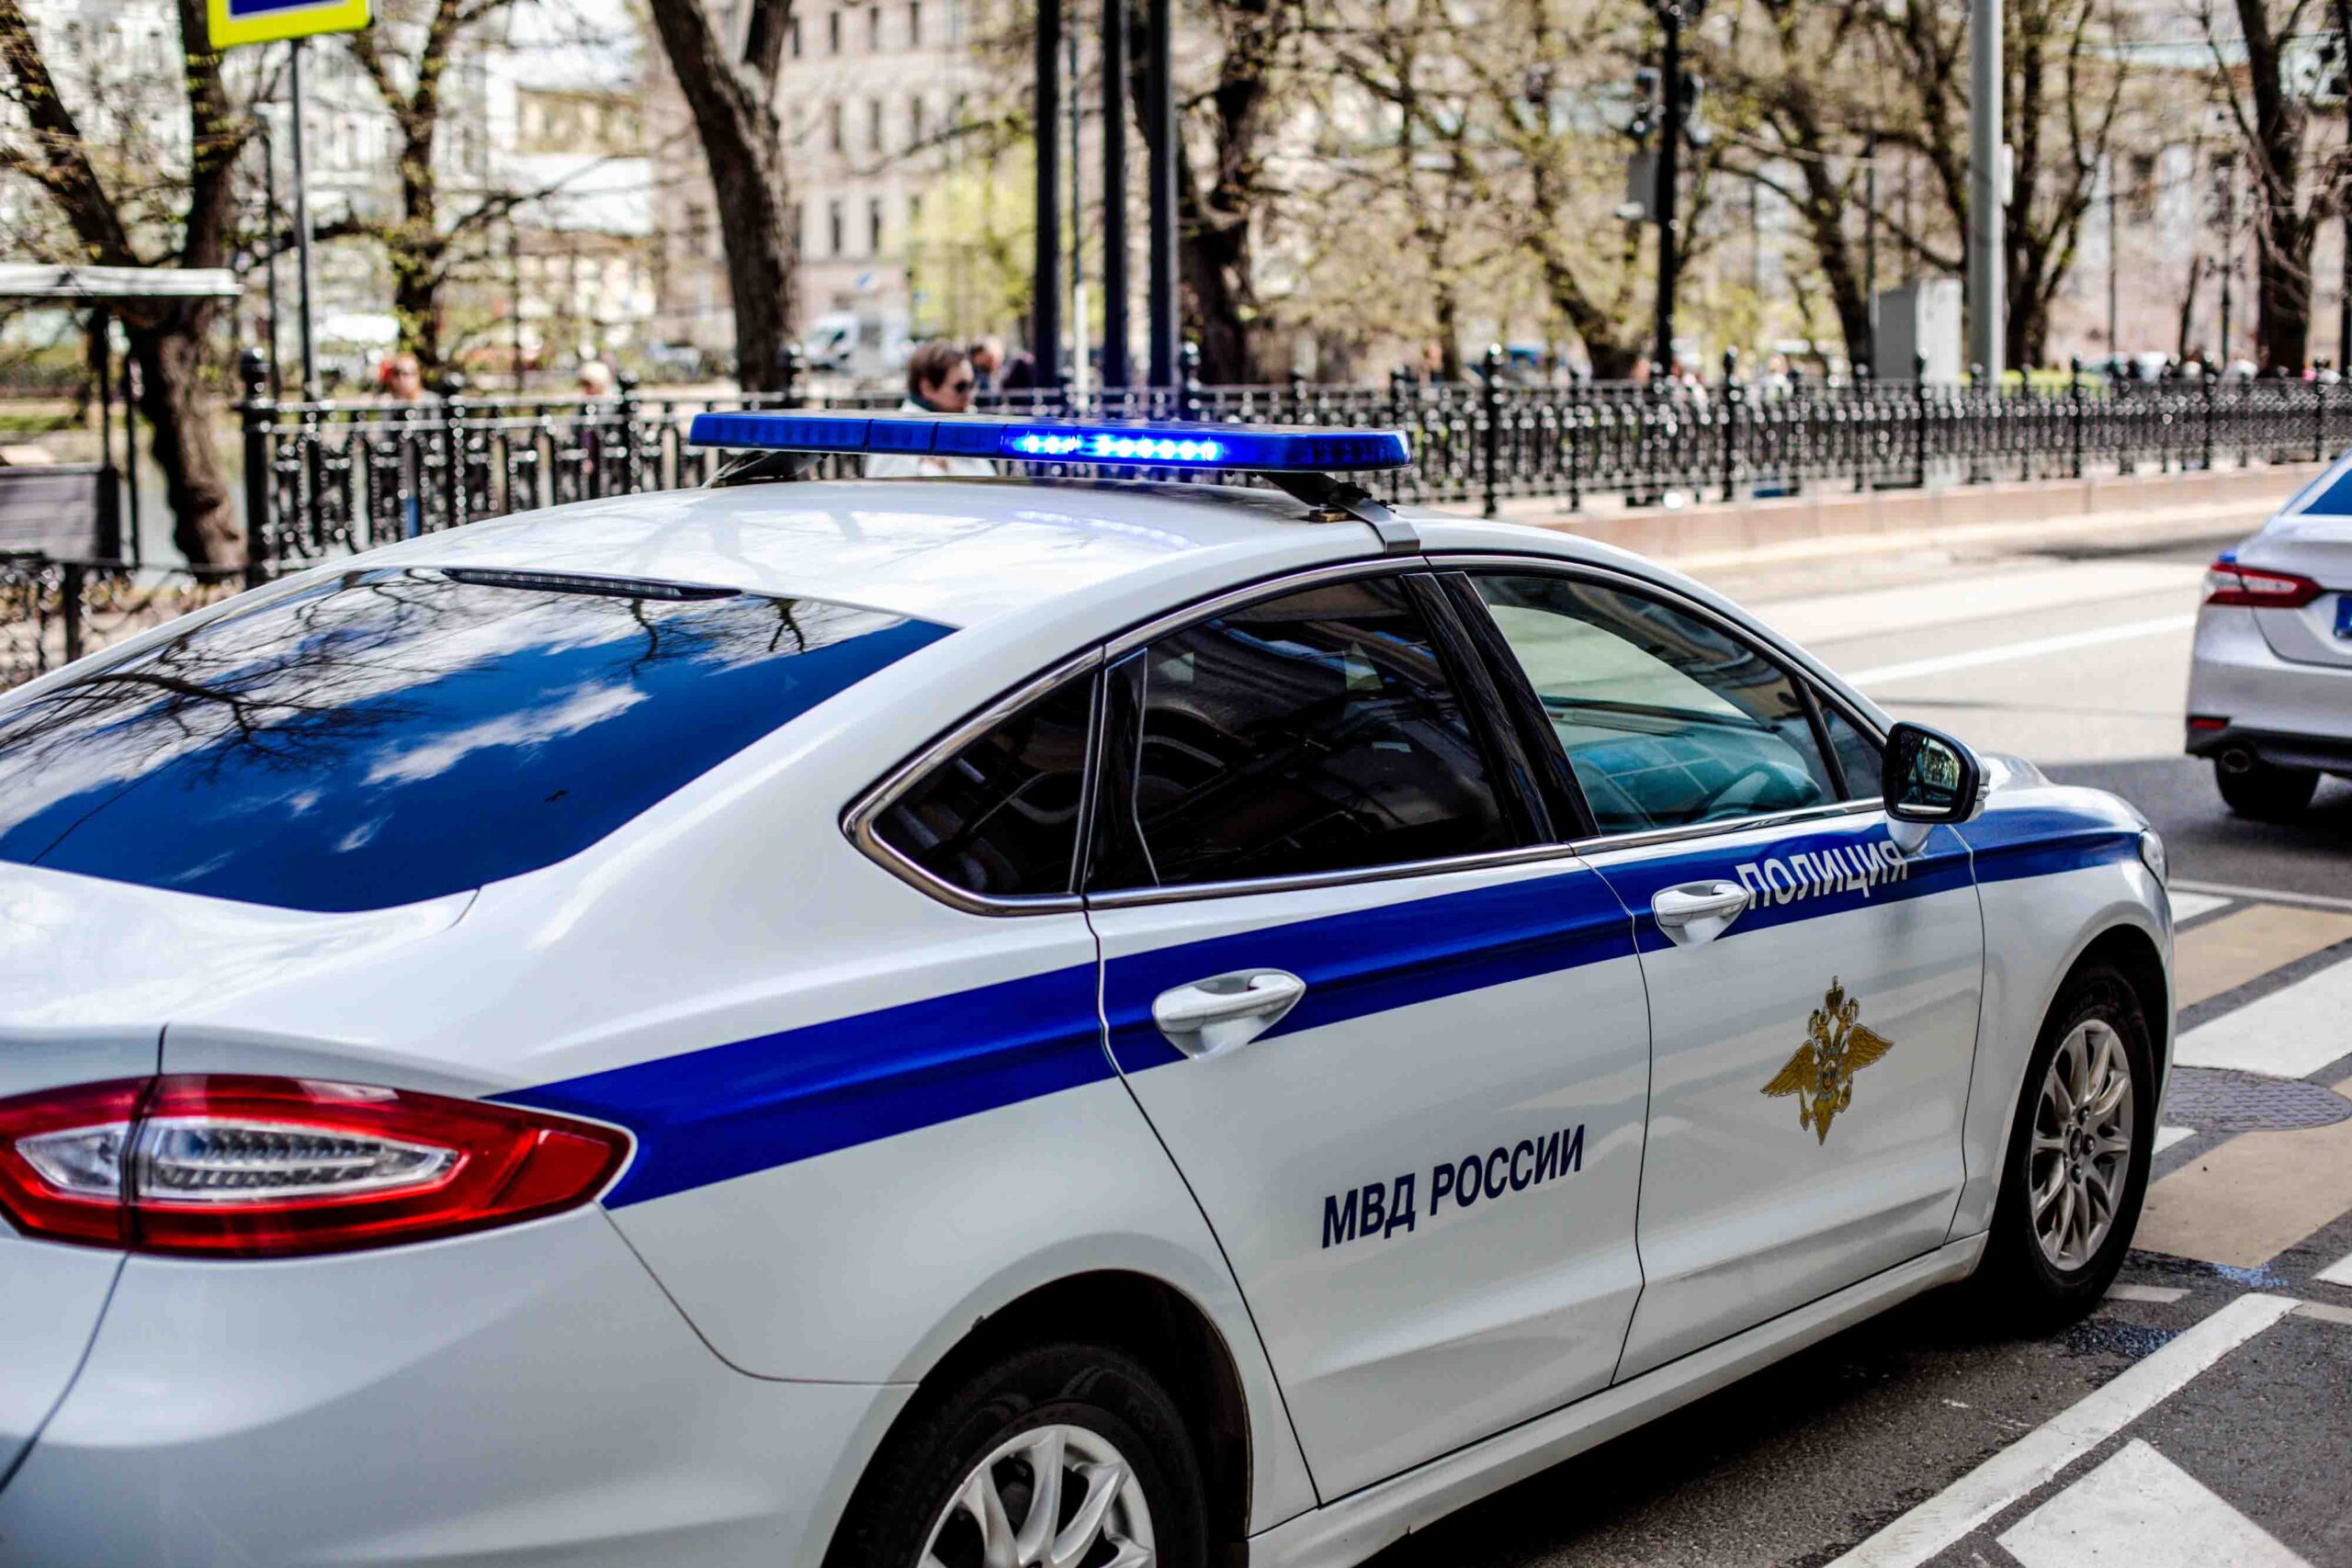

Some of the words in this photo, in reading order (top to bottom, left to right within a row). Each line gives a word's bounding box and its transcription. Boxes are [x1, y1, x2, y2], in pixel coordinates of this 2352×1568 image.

[1735, 840, 1908, 909] ПОЛИЦИЯ
[1322, 1173, 1416, 1248] МВД
[1430, 1124, 1585, 1216] РОССИИ
